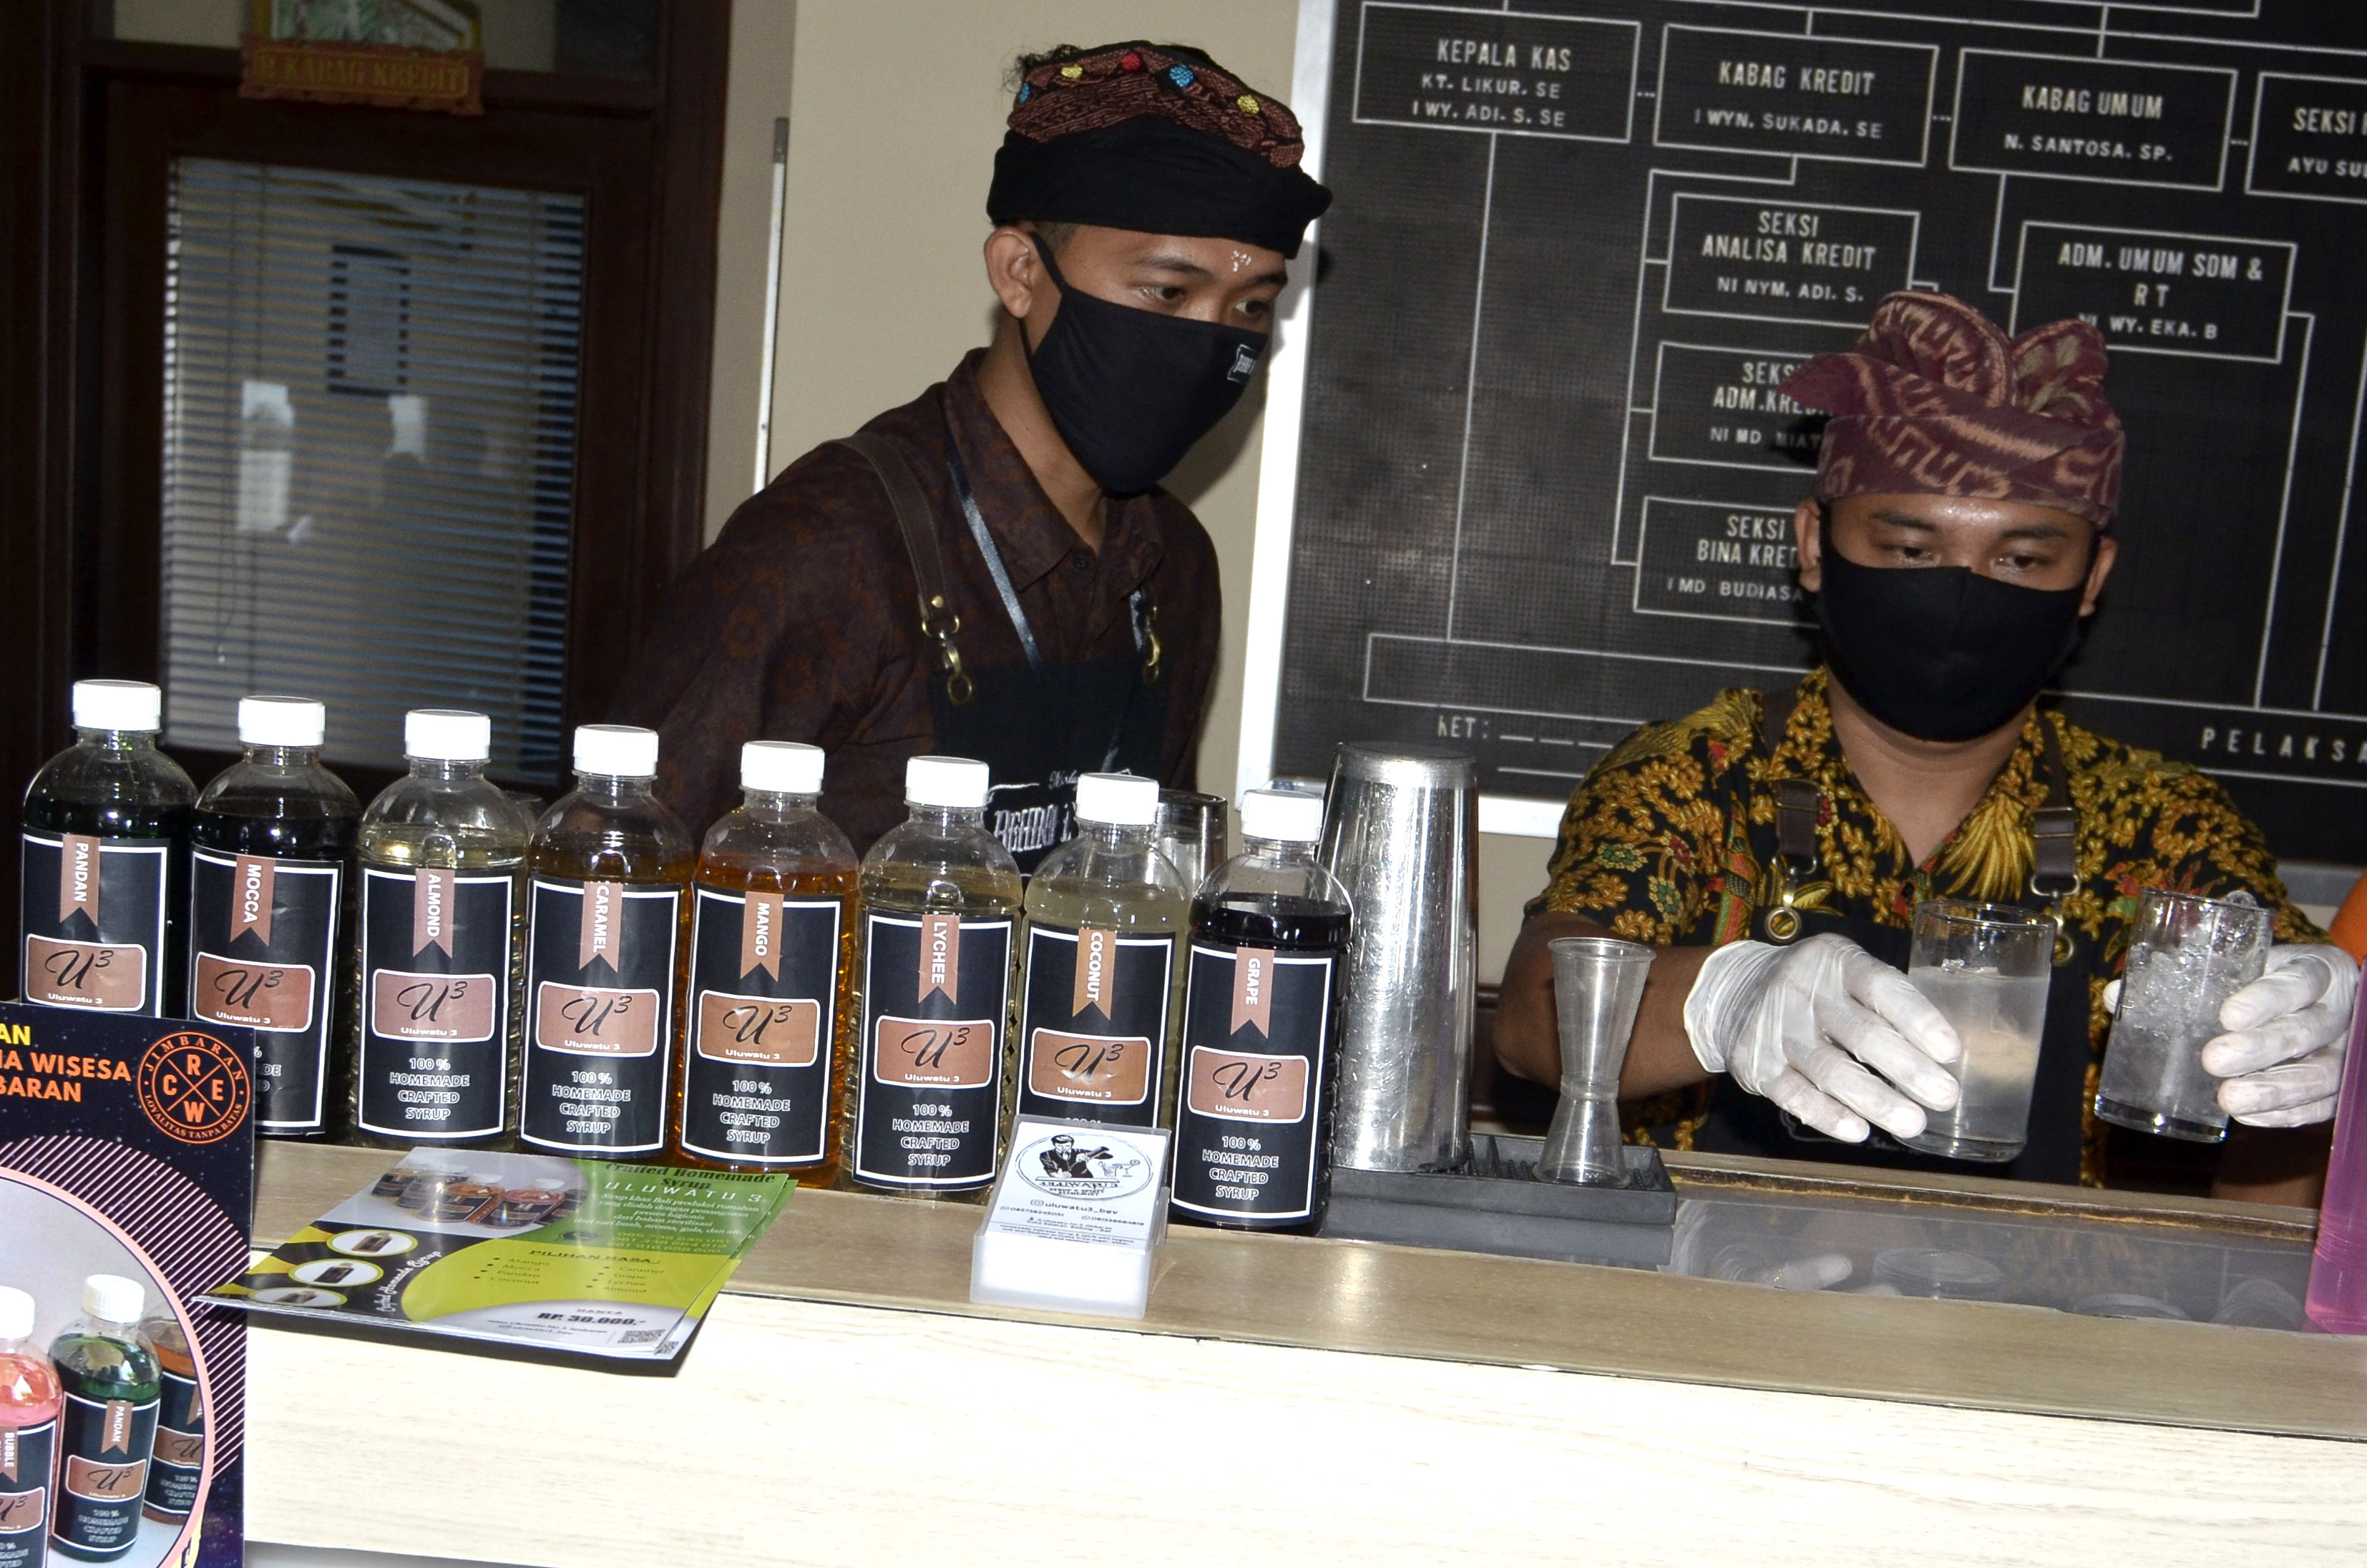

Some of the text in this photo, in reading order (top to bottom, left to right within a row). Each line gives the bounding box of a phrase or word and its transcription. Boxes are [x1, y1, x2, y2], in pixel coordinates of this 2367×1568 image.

[1438, 39, 1571, 72] KEPALA KAS
[1421, 74, 1561, 99] KT. LIKUR. SE
[1719, 62, 1875, 96] KABAG KREDIT
[2022, 85, 2164, 119] KABAG UMUM
[1426, 102, 1458, 119] WY.
[1465, 104, 1506, 122] ADI.
[1513, 107, 1531, 124] S.
[1539, 109, 1566, 127] SE
[2293, 107, 2357, 134] SEKSI
[1707, 109, 1754, 129] WYN.
[1762, 114, 1849, 136] SUKADA.
[1856, 121, 1883, 139] SE
[2004, 134, 2173, 162] N. SANTOSA. SP.
[2288, 157, 2329, 175] AYU
[1758, 211, 1818, 237] SEKSI
[1702, 234, 1876, 270] ANALISA KREDIT
[2058, 242, 2263, 282] ADM. UMUM SDM &
[1718, 277, 1738, 293] NI
[1744, 278, 1790, 298] NYM.
[1798, 281, 1838, 301] ADI.
[2109, 315, 2219, 340] WY. EKA. B
[1742, 362, 1803, 385] SEKS
[1710, 426, 1729, 442] NI
[1736, 428, 1762, 445] MD
[1726, 516, 1785, 542] SEKSI
[1697, 539, 1741, 564] BINA
[1679, 579, 1706, 595] MD
[73, 843, 89, 903] PANDAN
[243, 863, 263, 923] MOCCA
[427, 873, 443, 938] ALMOND
[592, 884, 610, 954] CARAMEL
[754, 901, 771, 957] MANGO
[931, 921, 947, 985] LYCHEE
[1085, 931, 1104, 1002] COCONUT
[1245, 957, 1260, 1005] GRAPE
[48, 993, 92, 1004] Uluwatu
[216, 1011, 261, 1024] Uluwatu
[401, 1026, 447, 1037] Uluwatu
[564, 1040, 610, 1050] Uluwatu
[145, 1036, 245, 1080] JIMBARAN
[725, 1049, 771, 1060] Uluwatu
[30, 1052, 132, 1082] WISESA
[409, 1058, 451, 1072] 100 %
[389, 1072, 469, 1087] HOMEMADE
[572, 1071, 613, 1085] 100 %
[732, 1080, 772, 1094] 100 %
[904, 1073, 950, 1083] Uluwatu
[398, 1090, 459, 1104] CRAFTED
[552, 1085, 631, 1102] HOMEMADE
[1056, 1086, 1103, 1097] Uluwatu
[559, 1103, 620, 1118] CRAFTED
[712, 1094, 791, 1112] HOMEMADE
[912, 1104, 952, 1117] 100 %
[1214, 1104, 1261, 1116] Uluwatu
[145, 1094, 243, 1140] LOYALITAS TANPA BATAS
[405, 1107, 451, 1120] SYRUP
[719, 1112, 780, 1128] CRAFTED
[566, 1120, 611, 1135] SYRUP
[892, 1118, 970, 1133] HOMEMADE
[726, 1130, 771, 1145] SYRUP
[900, 1136, 960, 1150] CRAFTED
[1221, 1135, 1261, 1151] 100 %
[907, 1153, 951, 1167] SYRUP
[1201, 1149, 1279, 1168] HOMEMADE
[660, 1177, 711, 1189] Syrup
[673, 1168, 775, 1183] Homemade
[1209, 1167, 1268, 1185] CRAFTED
[605, 1181, 736, 1200] ULUWATU
[1215, 1185, 1259, 1200] SYRUP
[1045, 1202, 1118, 1215] uluwatu3_bev
[529, 1250, 600, 1260] PILIHAN
[112, 1406, 125, 1443] PANDAN
[4, 1432, 15, 1468] BUBBLE
